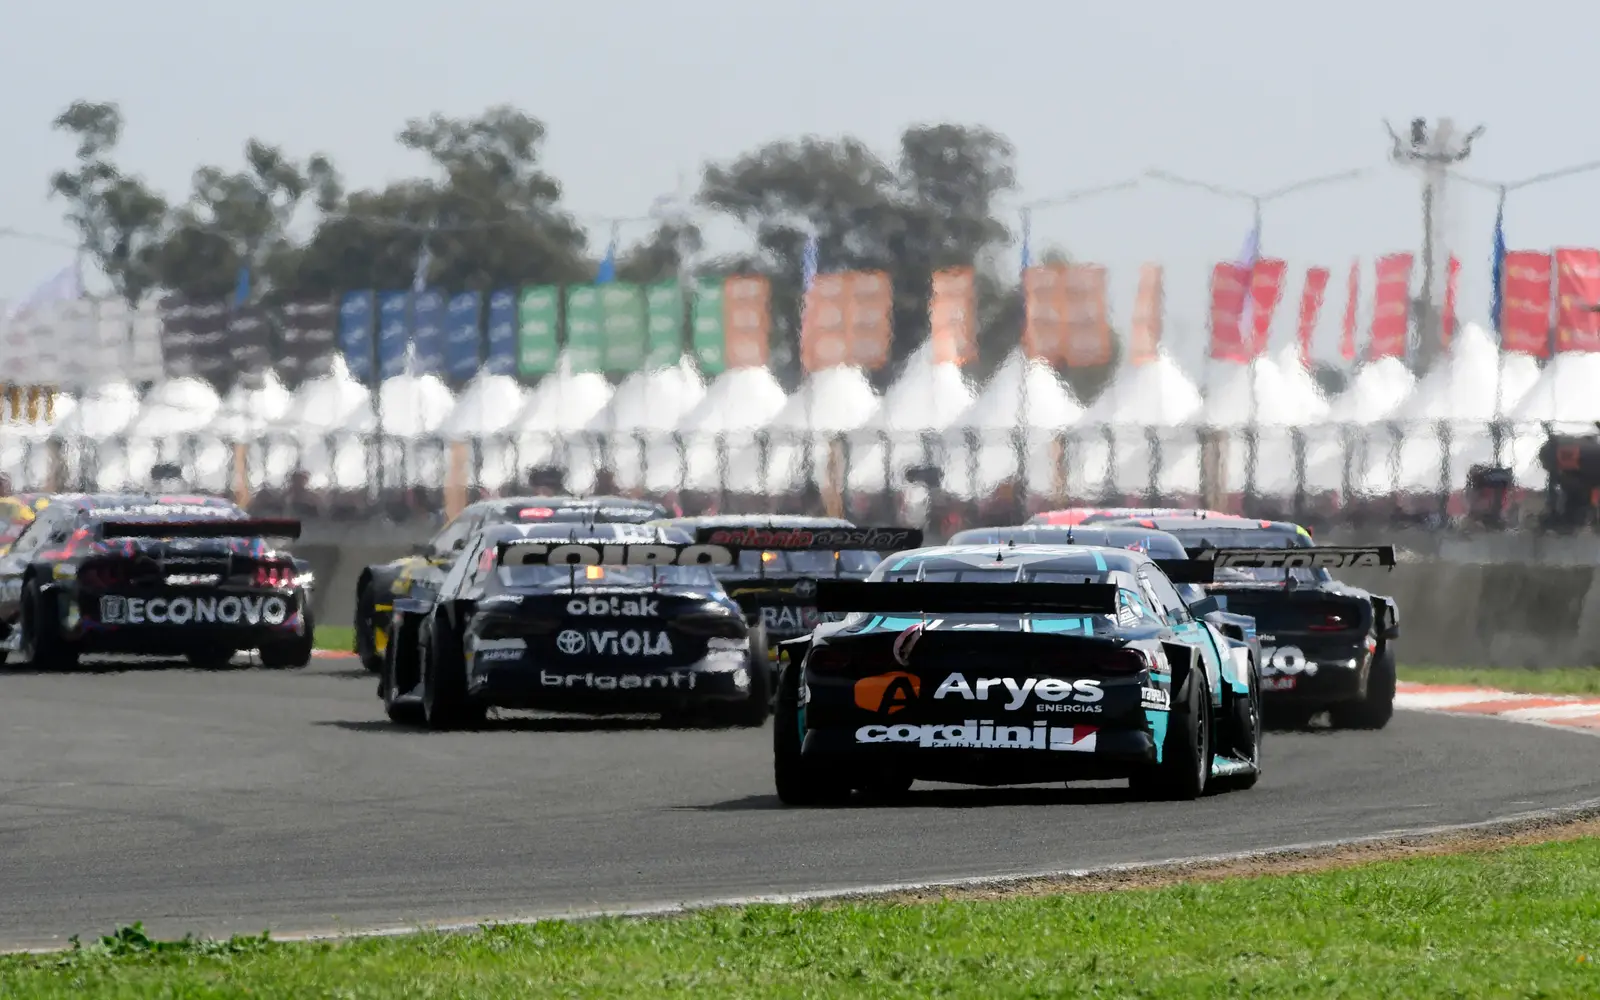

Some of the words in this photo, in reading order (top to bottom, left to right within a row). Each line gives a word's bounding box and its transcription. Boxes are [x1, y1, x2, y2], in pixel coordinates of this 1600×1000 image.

[127, 596, 286, 625] ECONOVO
[933, 672, 1104, 711] Aryes
[1036, 703, 1103, 713] ENERGIAS
[855, 719, 1047, 750] cordini
